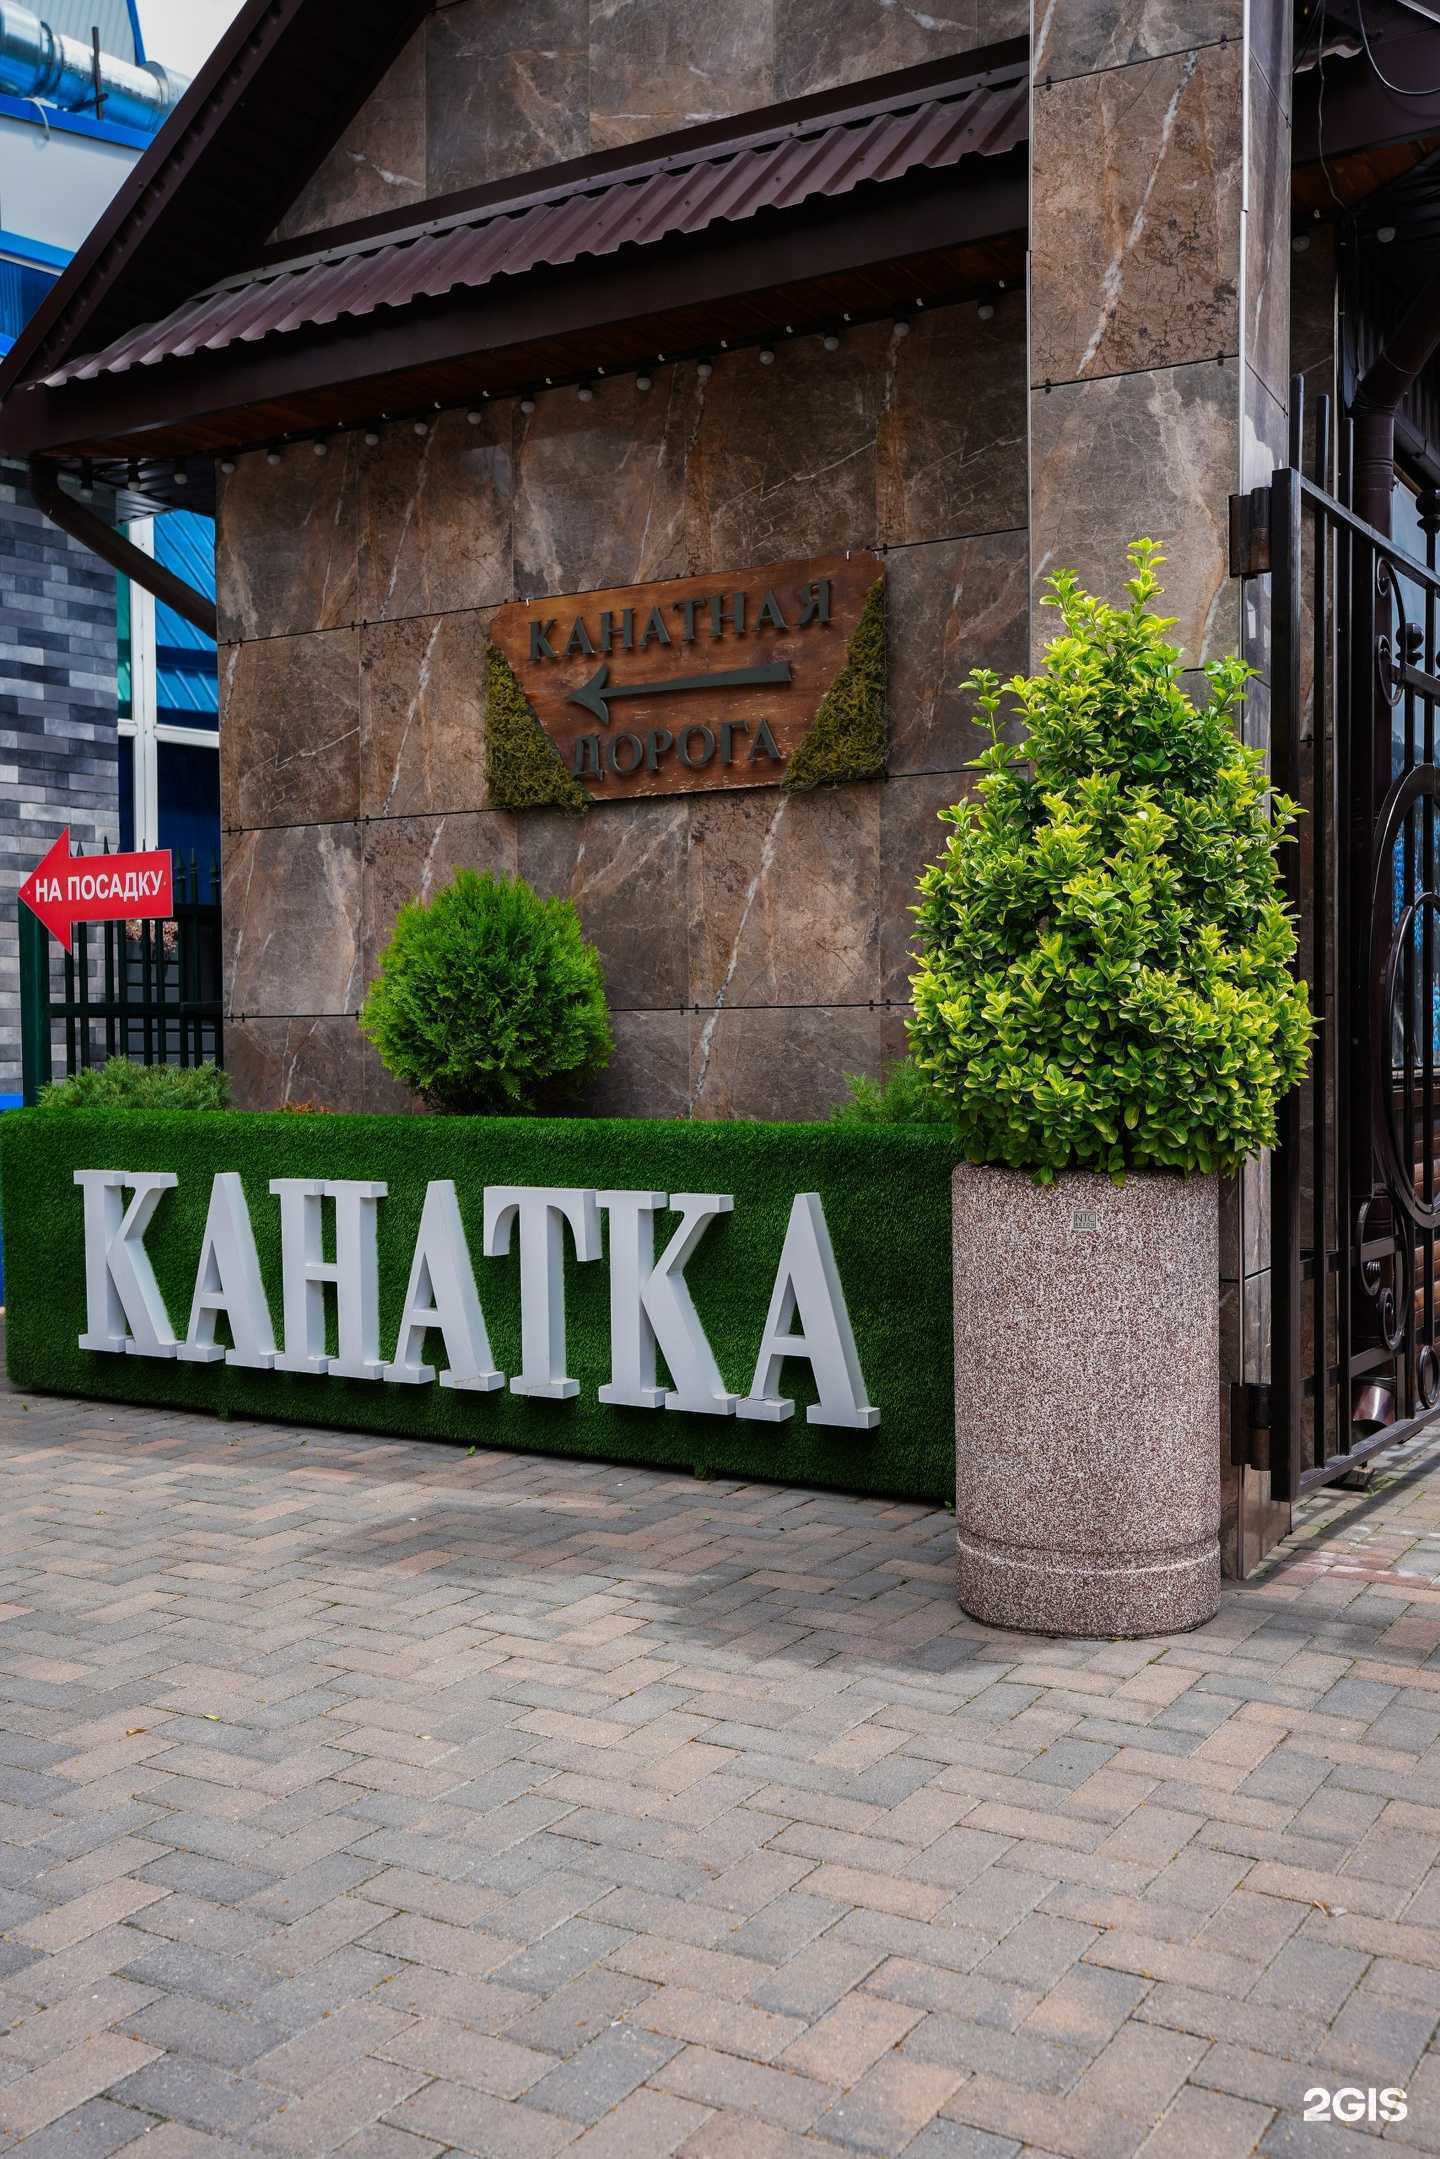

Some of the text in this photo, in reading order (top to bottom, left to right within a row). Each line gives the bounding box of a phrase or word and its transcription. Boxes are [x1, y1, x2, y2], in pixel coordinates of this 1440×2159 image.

[528, 578, 833, 663] КАНАТНАЯ
[572, 719, 783, 782] ДОРОГА
[35, 870, 163, 903] НА ПОСАДКУ
[73, 1169, 881, 1429] КАНАТКА
